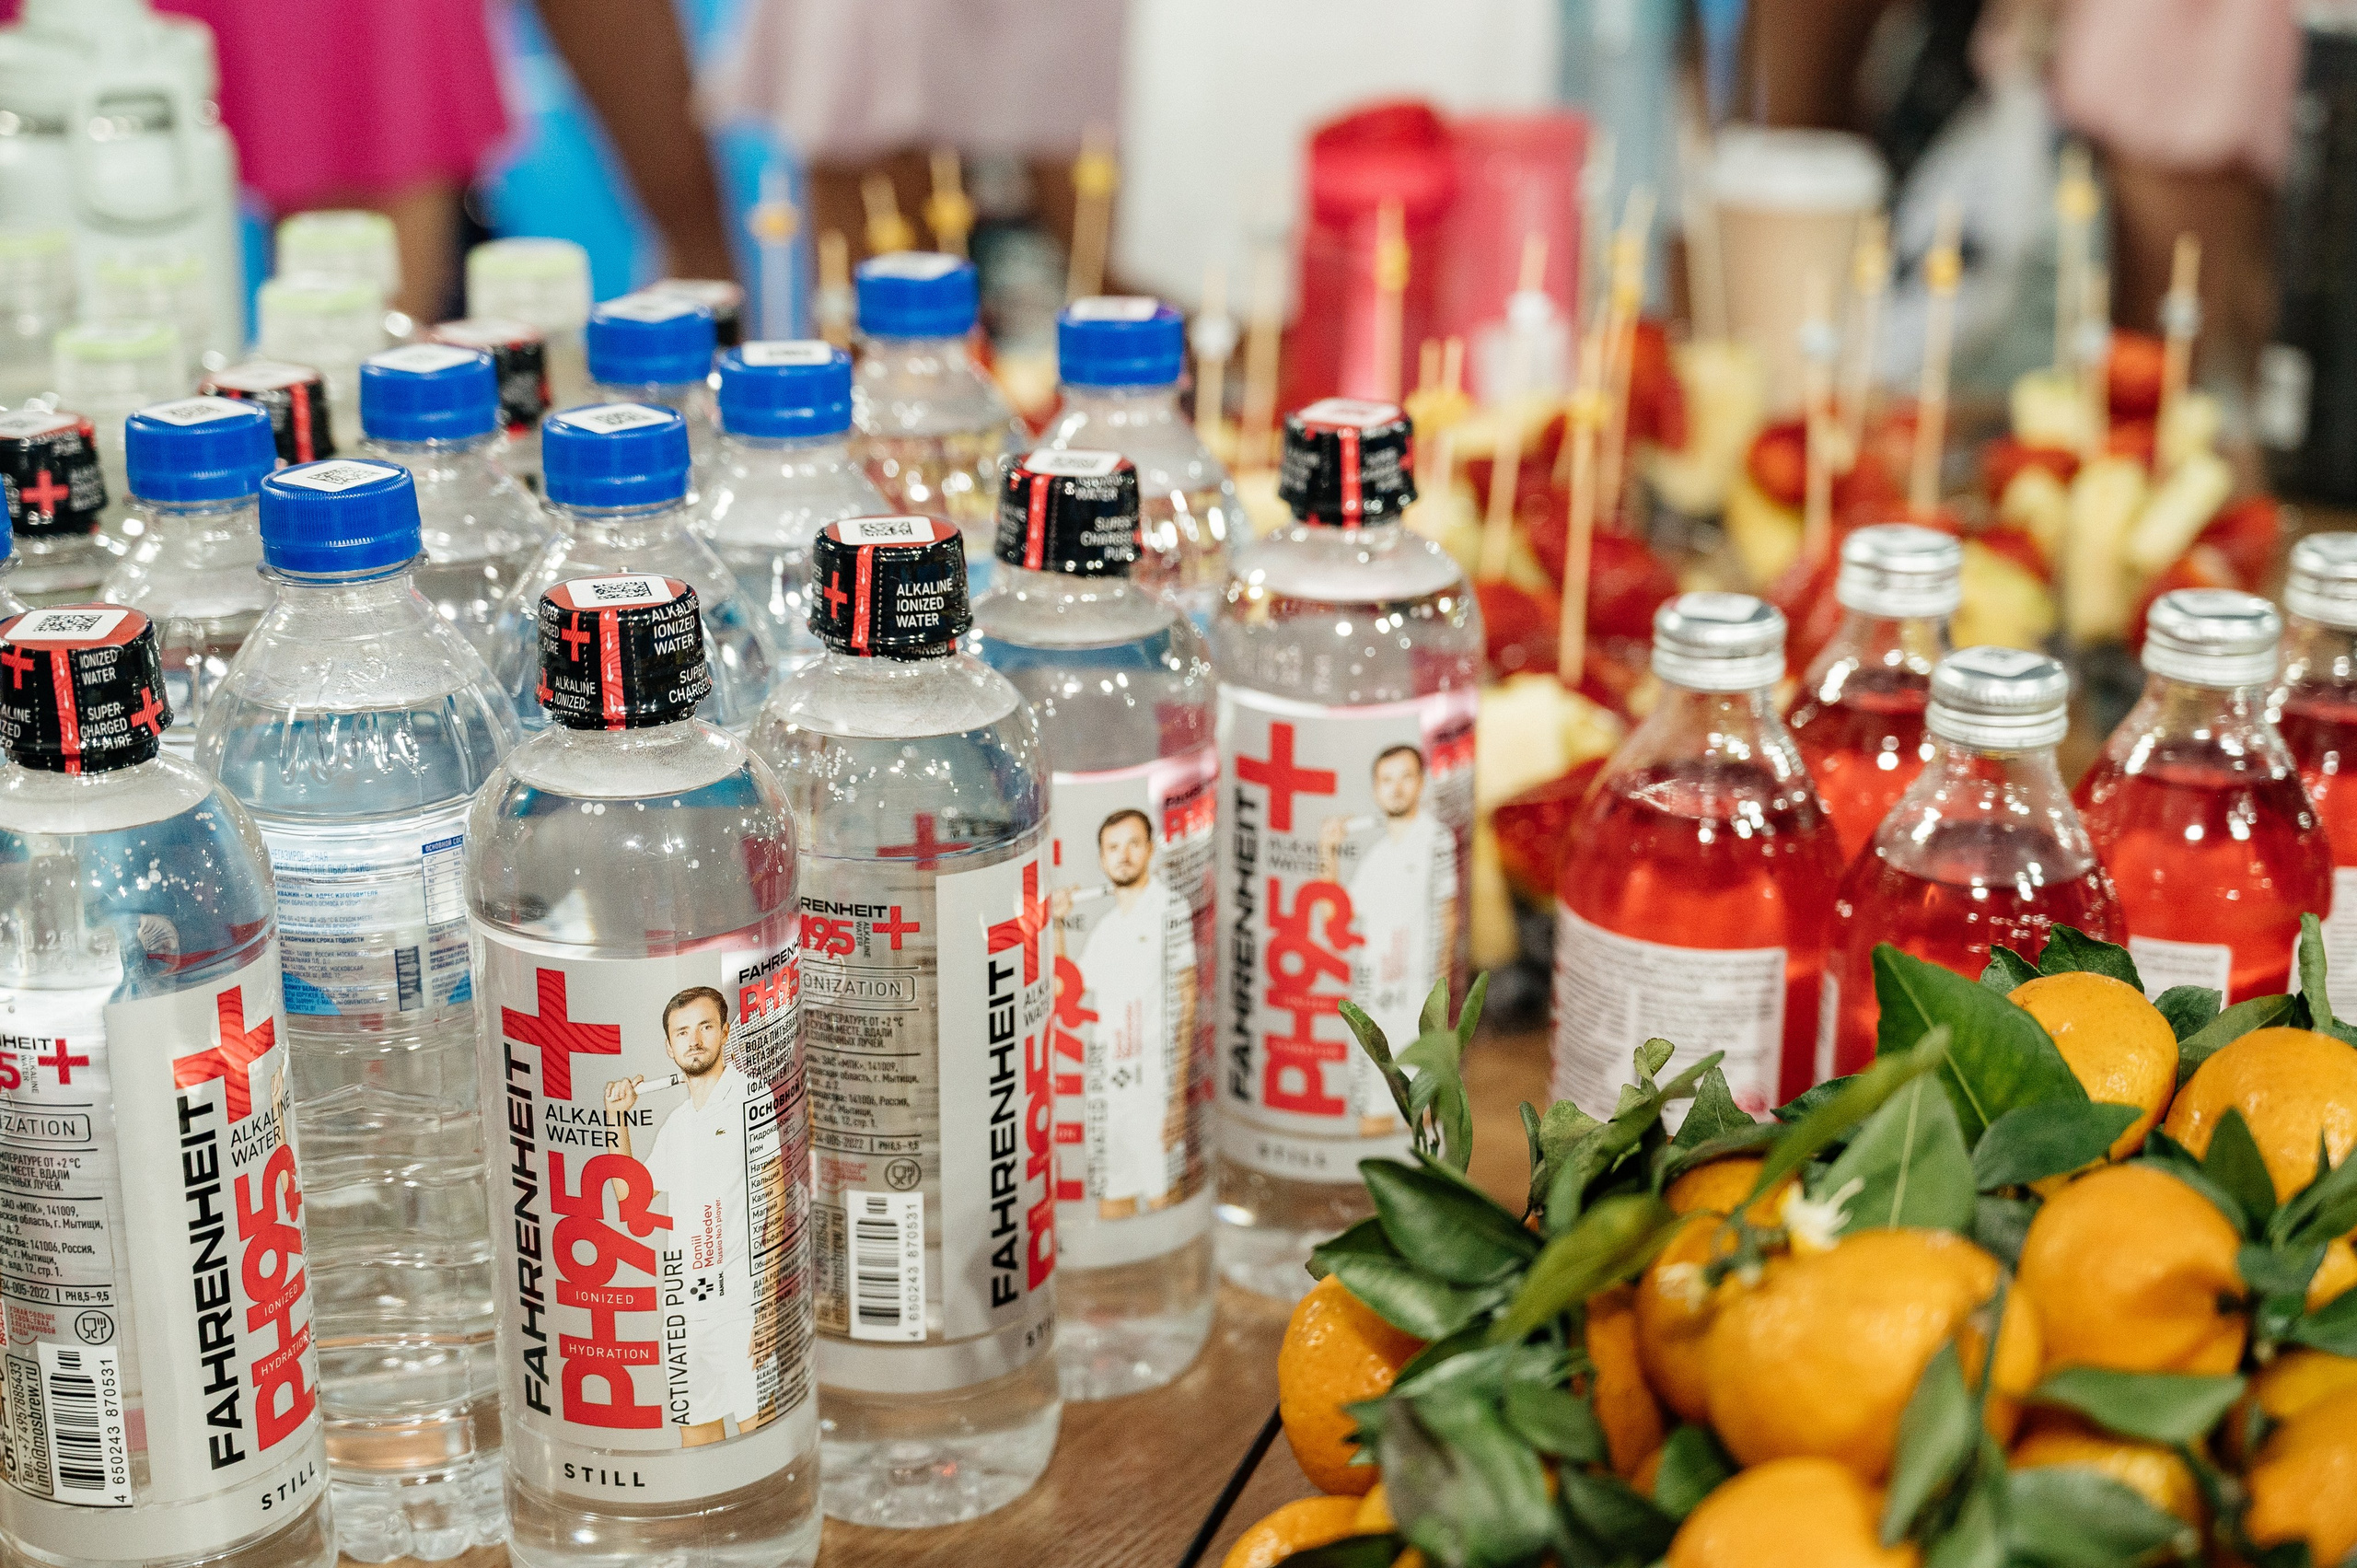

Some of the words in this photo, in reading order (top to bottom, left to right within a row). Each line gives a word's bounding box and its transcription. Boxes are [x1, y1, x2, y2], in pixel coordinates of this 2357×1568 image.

[896, 577, 954, 597] ALKALINE
[652, 596, 700, 622] ALKALINE
[897, 597, 945, 612] IONIZED
[654, 615, 696, 639] IONIZED
[896, 613, 940, 628] WATER
[655, 633, 694, 656] WATER
[79, 649, 118, 668] IONIZED
[81, 668, 117, 686] WATER
[555, 675, 597, 695] ALKALINE
[554, 691, 586, 709] IONIZED
[668, 678, 711, 703] CHARGED
[87, 702, 125, 721] SUPER-
[80, 717, 128, 739] CHARGED
[801, 897, 887, 918] RENHEIT
[1229, 787, 1259, 1102] FAHRENHEIT
[0, 1034, 52, 1051] HEIT
[746, 1034, 769, 1052] ВОДА
[21, 1054, 30, 1082] WATER
[29, 1054, 39, 1095] ALKALINE
[230, 1090, 290, 1148] ALKALINE
[545, 1103, 654, 1127] ALKALINE
[546, 1123, 620, 1148] WATER
[989, 960, 1019, 1308] FAHRENHEIT
[231, 1125, 282, 1168] WATER
[749, 1144, 764, 1155] ион
[43, 1156, 55, 1167] ОТ
[57, 1158, 67, 1168] +2
[750, 1156, 776, 1174] Натрий
[11, 1166, 39, 1179] МЕСТЕ,
[40, 1168, 70, 1180] ВДАЛИ
[751, 1168, 781, 1188] Кальций
[33, 1178, 64, 1191] ЛУЧЕЙ.
[752, 1188, 774, 1204] Калий
[46, 1204, 79, 1217] 141009,
[715, 1197, 724, 1224] player.
[752, 1200, 778, 1219] Магний
[19, 1214, 53, 1228] область,
[63, 1217, 104, 1230] Мытищи,
[504, 1041, 552, 1416] FAHRENHEIT
[753, 1215, 783, 1235] Хлориды
[906, 1203, 919, 1258] 870531
[30, 1238, 61, 1254] 141006,
[62, 1242, 96, 1254] Россия,
[702, 1204, 714, 1269] Medvedev
[754, 1229, 785, 1249] Сульфаты
[21, 1249, 57, 1265] Мытищи,
[691, 1235, 703, 1270] Daniil
[38, 1267, 53, 1278] стр.
[55, 1266, 63, 1277] 1.
[663, 1249, 685, 1307] PURE
[177, 1095, 246, 1470] FAHRENHEIT
[753, 1276, 770, 1291] ДАТА
[264, 1283, 299, 1318] IONIZED
[575, 1290, 634, 1305] IONIZED
[908, 1266, 920, 1320] 650243
[569, 1342, 650, 1360] HYDRATION
[667, 1316, 691, 1426] ACTIVATED
[10, 1362, 29, 1434] 4957885433
[100, 1359, 119, 1417] 870531
[25, 1366, 50, 1488] info@mosbrew.ru
[18, 1434, 30, 1452] +7
[108, 1426, 125, 1484] 650243
[564, 1462, 645, 1487] STILL
[261, 1461, 316, 1510] STILL
[114, 1494, 127, 1503] 4
